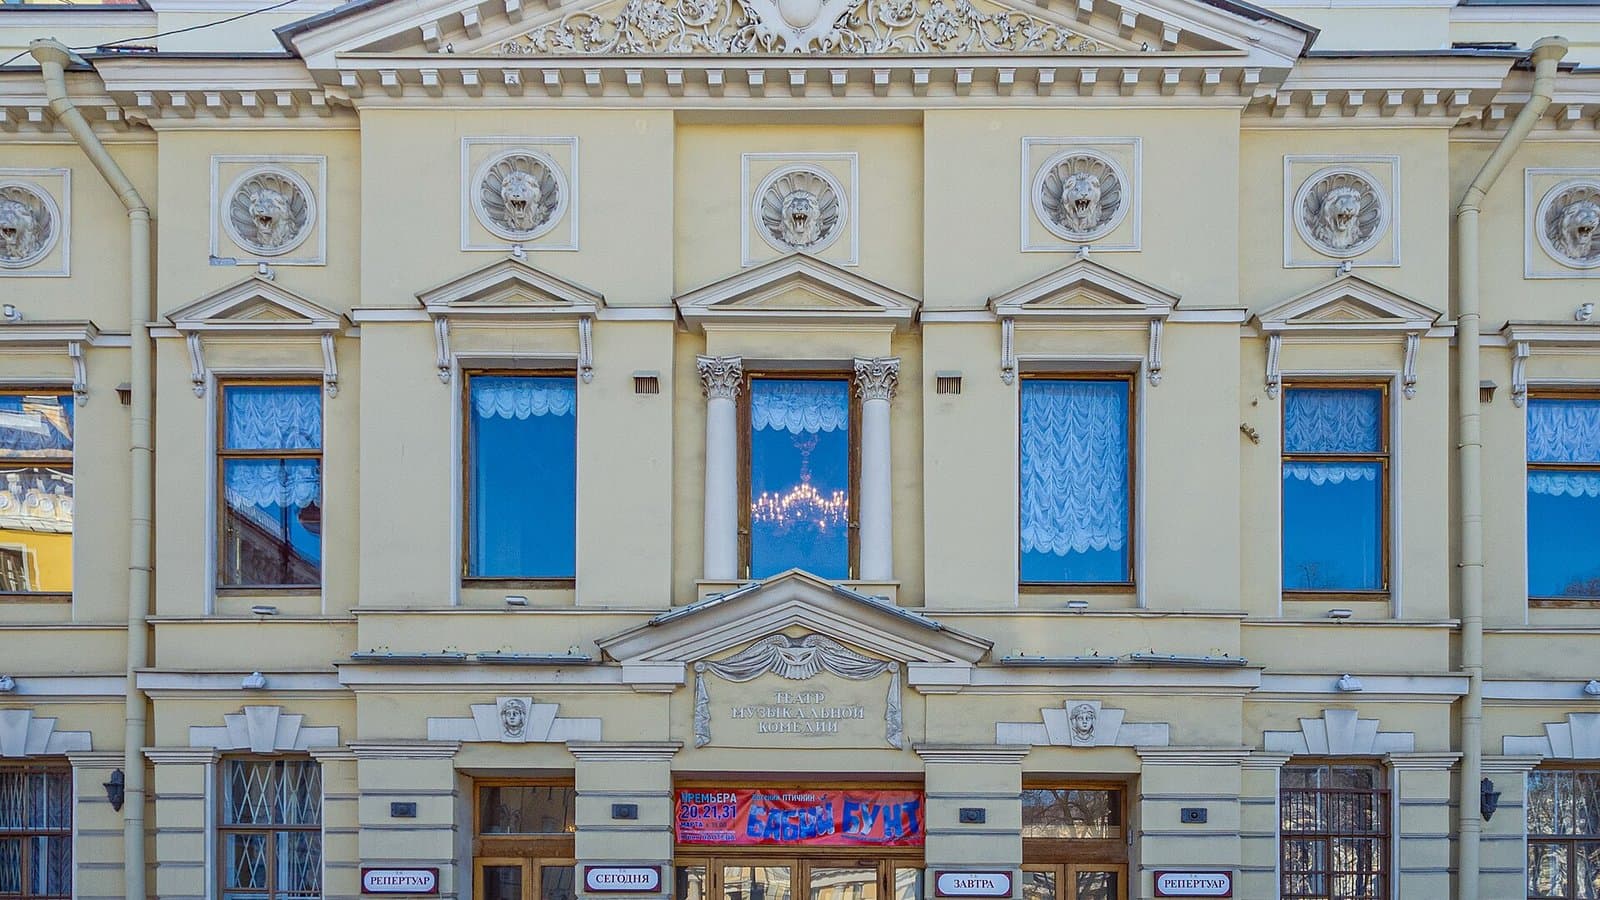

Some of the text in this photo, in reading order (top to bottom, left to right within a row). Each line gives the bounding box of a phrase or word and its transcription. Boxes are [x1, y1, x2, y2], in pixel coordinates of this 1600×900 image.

[775, 691, 825, 704] ТЕАТР
[731, 705, 865, 719] МУЗЫКАЛЬНОЙ
[758, 721, 839, 733] КОМЕДИИ
[681, 793, 737, 803] ПРЕМЬЕРА
[842, 800, 919, 838] БУНТ
[370, 876, 430, 885] РЕПЕРТУАР
[595, 874, 649, 884] СЕГОДНЯ
[953, 879, 995, 889] ЗАВТРА
[1164, 879, 1225, 888] РЕПЕРТУАР
